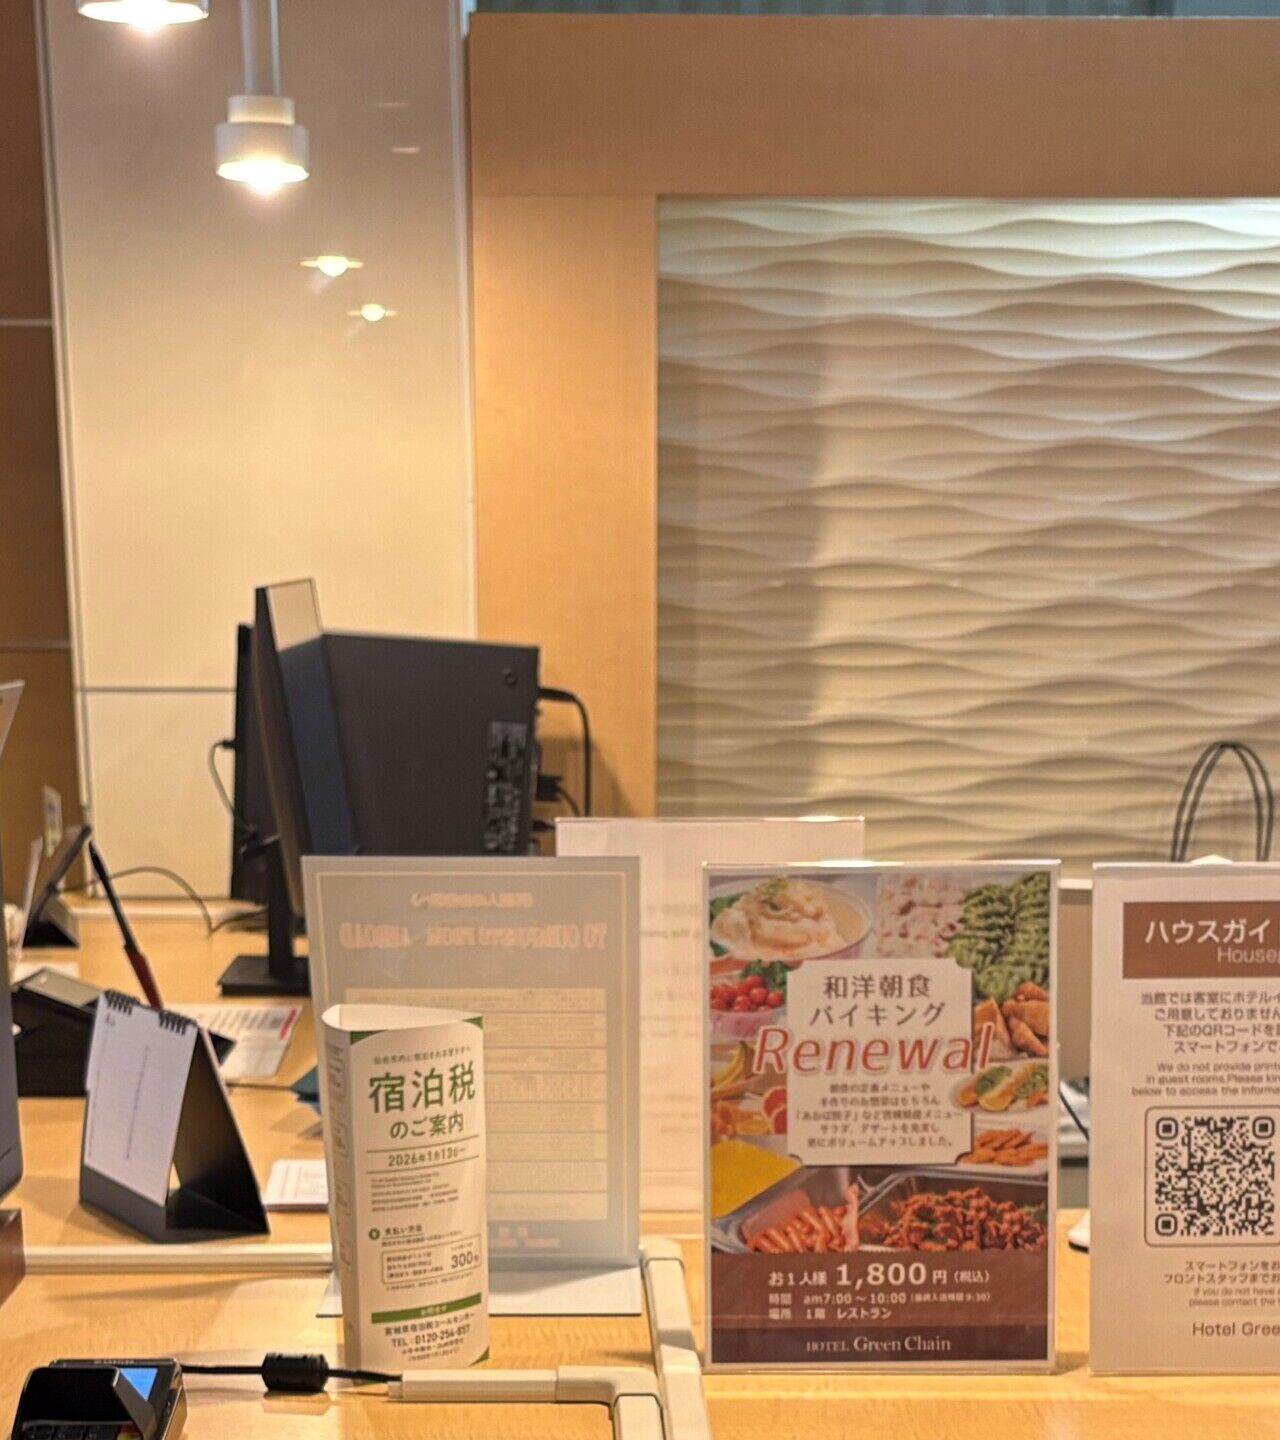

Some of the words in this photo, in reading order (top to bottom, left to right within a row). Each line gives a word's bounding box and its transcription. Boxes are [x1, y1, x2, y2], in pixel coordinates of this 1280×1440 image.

[824, 974, 931, 999] 和洋朝食
[810, 1002, 946, 1027] バイキング
[753, 1022, 995, 1075] Renewal
[1157, 1061, 1174, 1073] We
[1177, 1061, 1190, 1073] do
[1193, 1061, 1210, 1073] not
[1213, 1061, 1251, 1073] provide
[368, 1060, 475, 1113] 宿泊税
[390, 1111, 464, 1139] のご案内
[836, 1262, 927, 1291] 1,800
[932, 1269, 948, 1285] 円
[768, 1293, 792, 1306] 時間
[837, 1308, 892, 1320] レストラン
[1192, 1322, 1235, 1337] Hotel
[807, 1341, 849, 1353] HOTEL
[853, 1336, 902, 1352] Green
[905, 1335, 951, 1352] Chain
